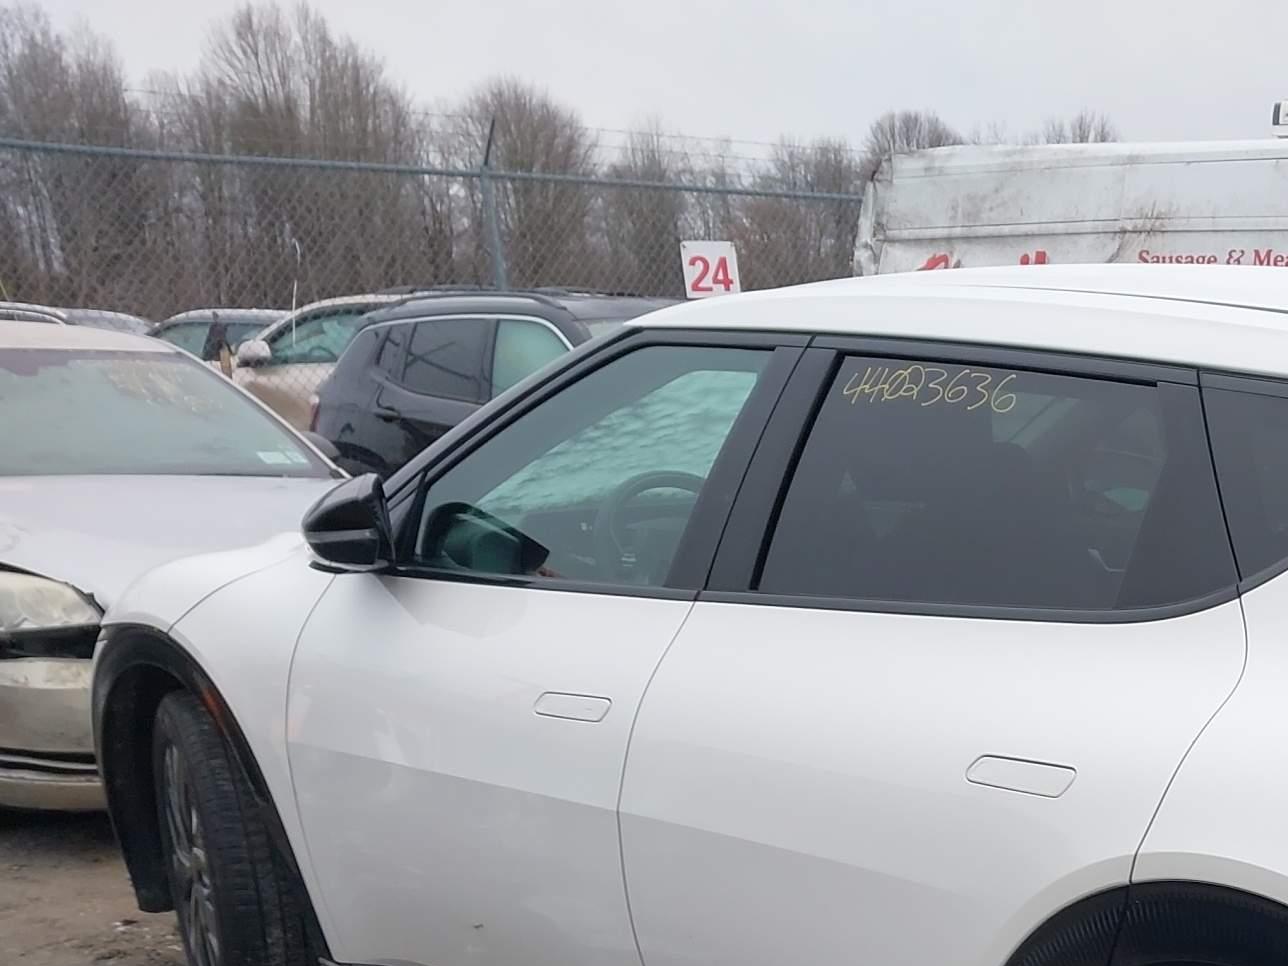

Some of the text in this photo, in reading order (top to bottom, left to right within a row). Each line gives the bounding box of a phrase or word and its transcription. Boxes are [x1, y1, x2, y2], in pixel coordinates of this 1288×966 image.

[689, 255, 734, 292] 24
[1137, 249, 1218, 265] Sausage
[1226, 249, 1245, 266] &
[842, 364, 1017, 413] 44023636
